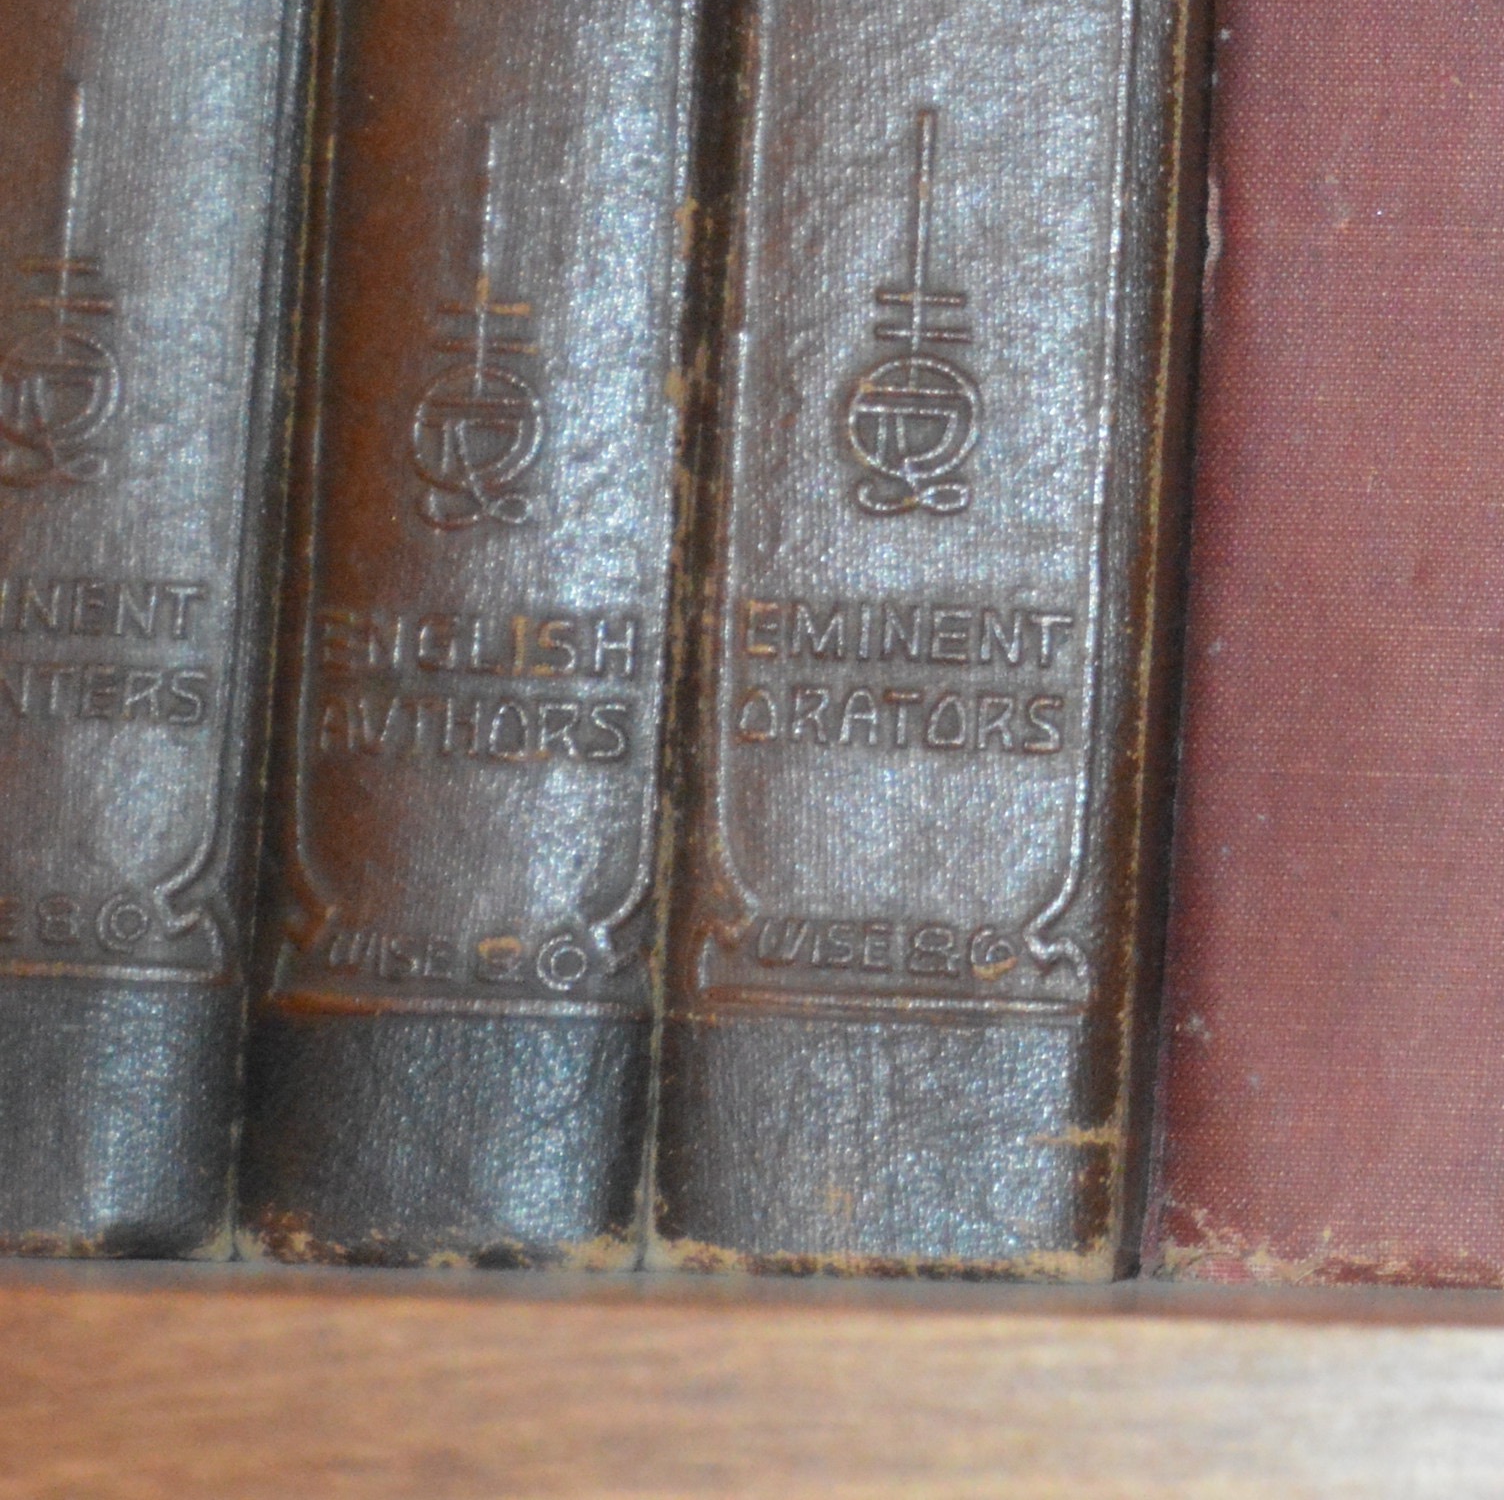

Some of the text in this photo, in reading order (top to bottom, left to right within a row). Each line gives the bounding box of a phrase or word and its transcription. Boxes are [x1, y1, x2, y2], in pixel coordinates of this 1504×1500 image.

[318, 610, 636, 676] ENGLISH
[744, 600, 1074, 668] EMINENT
[736, 686, 1066, 754] ORATORS
[754, 920, 893, 972] WISE
